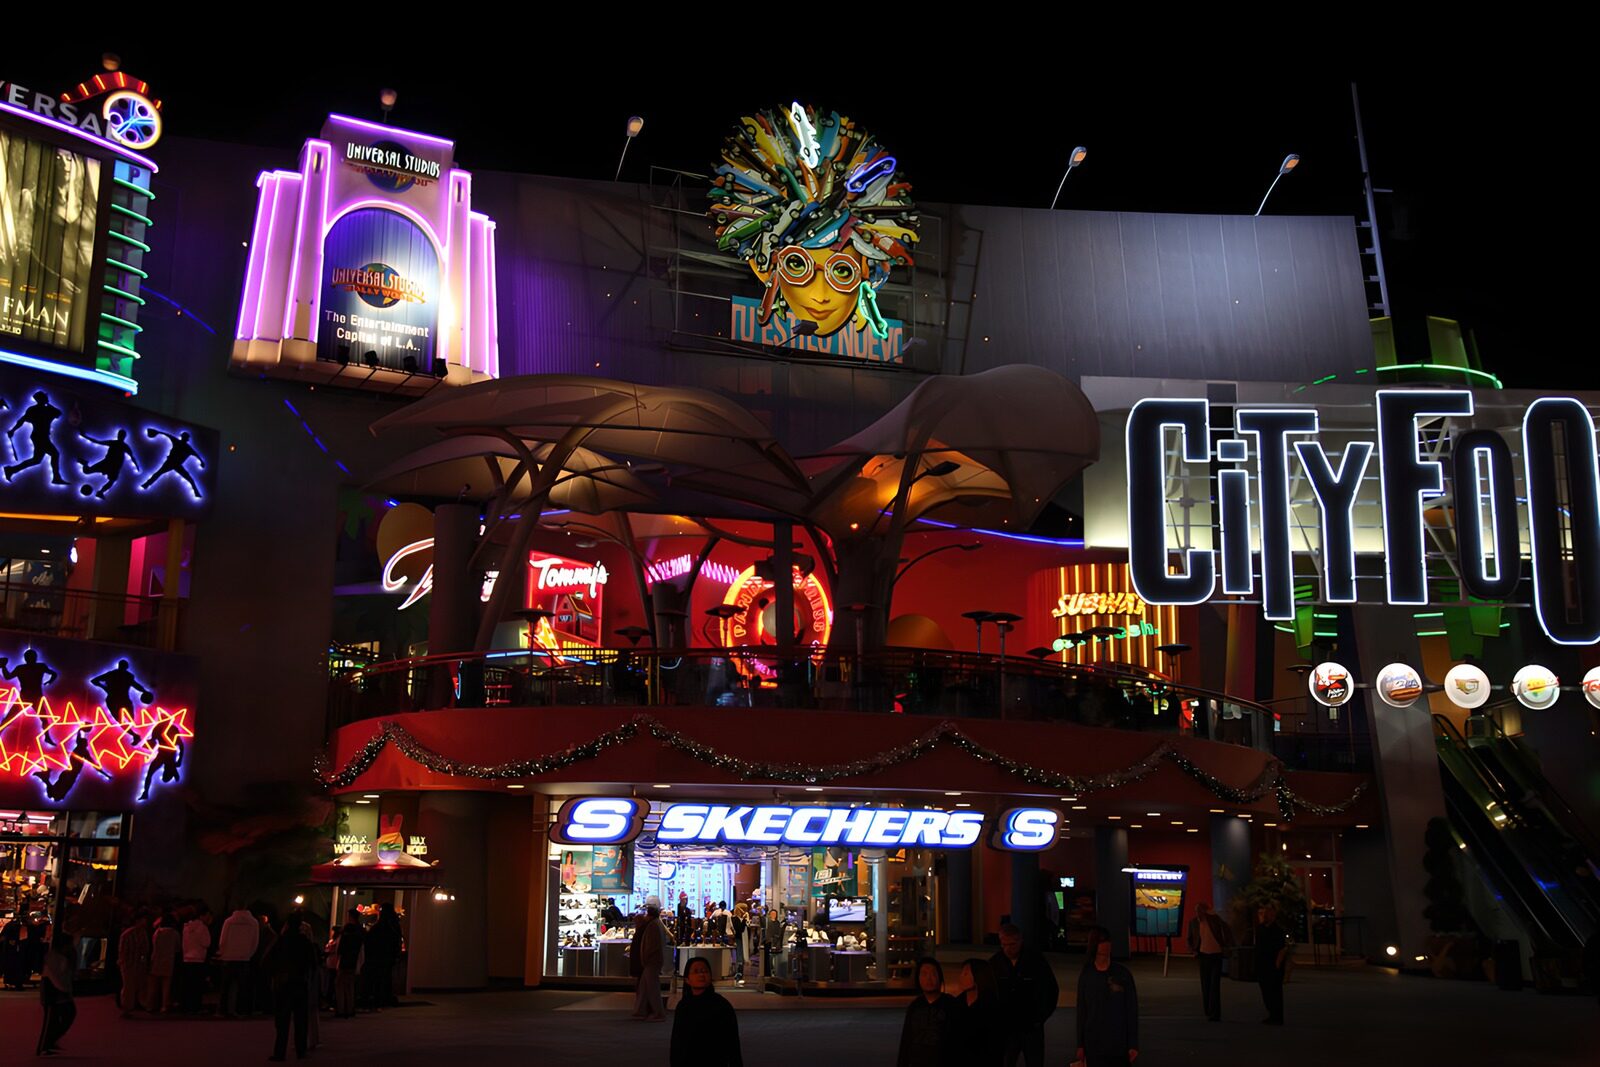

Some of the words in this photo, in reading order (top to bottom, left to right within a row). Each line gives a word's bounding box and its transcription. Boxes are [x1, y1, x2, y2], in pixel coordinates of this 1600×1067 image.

[346, 142, 402, 168] UNIVERSAL
[405, 154, 440, 178] STUDIOS
[332, 268, 388, 288] UNIVERSAL
[325, 310, 346, 324] The
[350, 314, 429, 337] Entertainment
[336, 327, 377, 344] Capital
[529, 557, 609, 599] Tommy's
[656, 803, 985, 848] SKECHERS
[334, 844, 371, 854] WORKS
[340, 835, 367, 844] WAX
[1137, 872, 1183, 880] DIRECTORY
